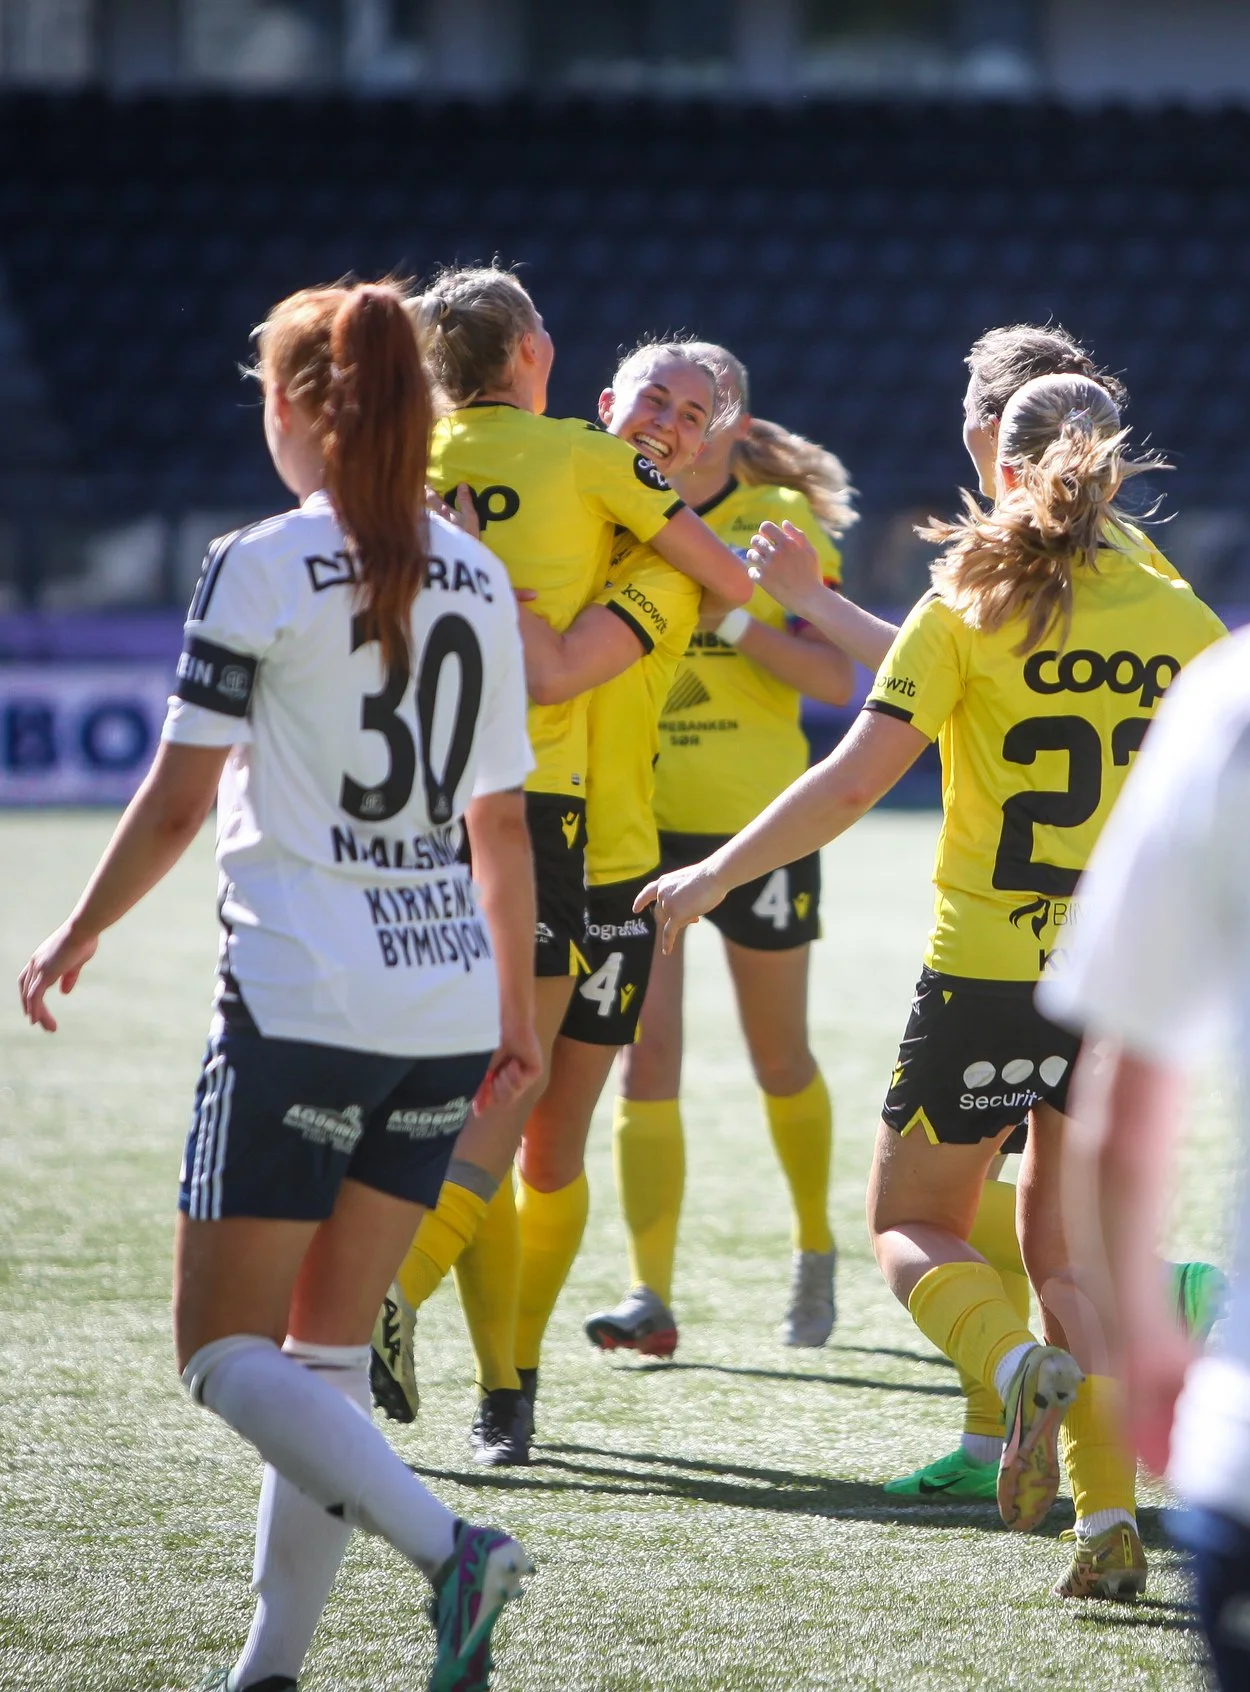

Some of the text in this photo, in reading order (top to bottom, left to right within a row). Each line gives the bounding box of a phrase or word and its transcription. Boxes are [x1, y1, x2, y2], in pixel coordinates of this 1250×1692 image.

[620, 582, 669, 635] knowit
[177, 651, 214, 688] EIN
[1022, 648, 1182, 709] coop
[3, 697, 150, 773] BO
[338, 611, 484, 825] 30
[588, 918, 649, 941] ografikk
[752, 867, 791, 931] 4
[579, 951, 623, 1017] 4
